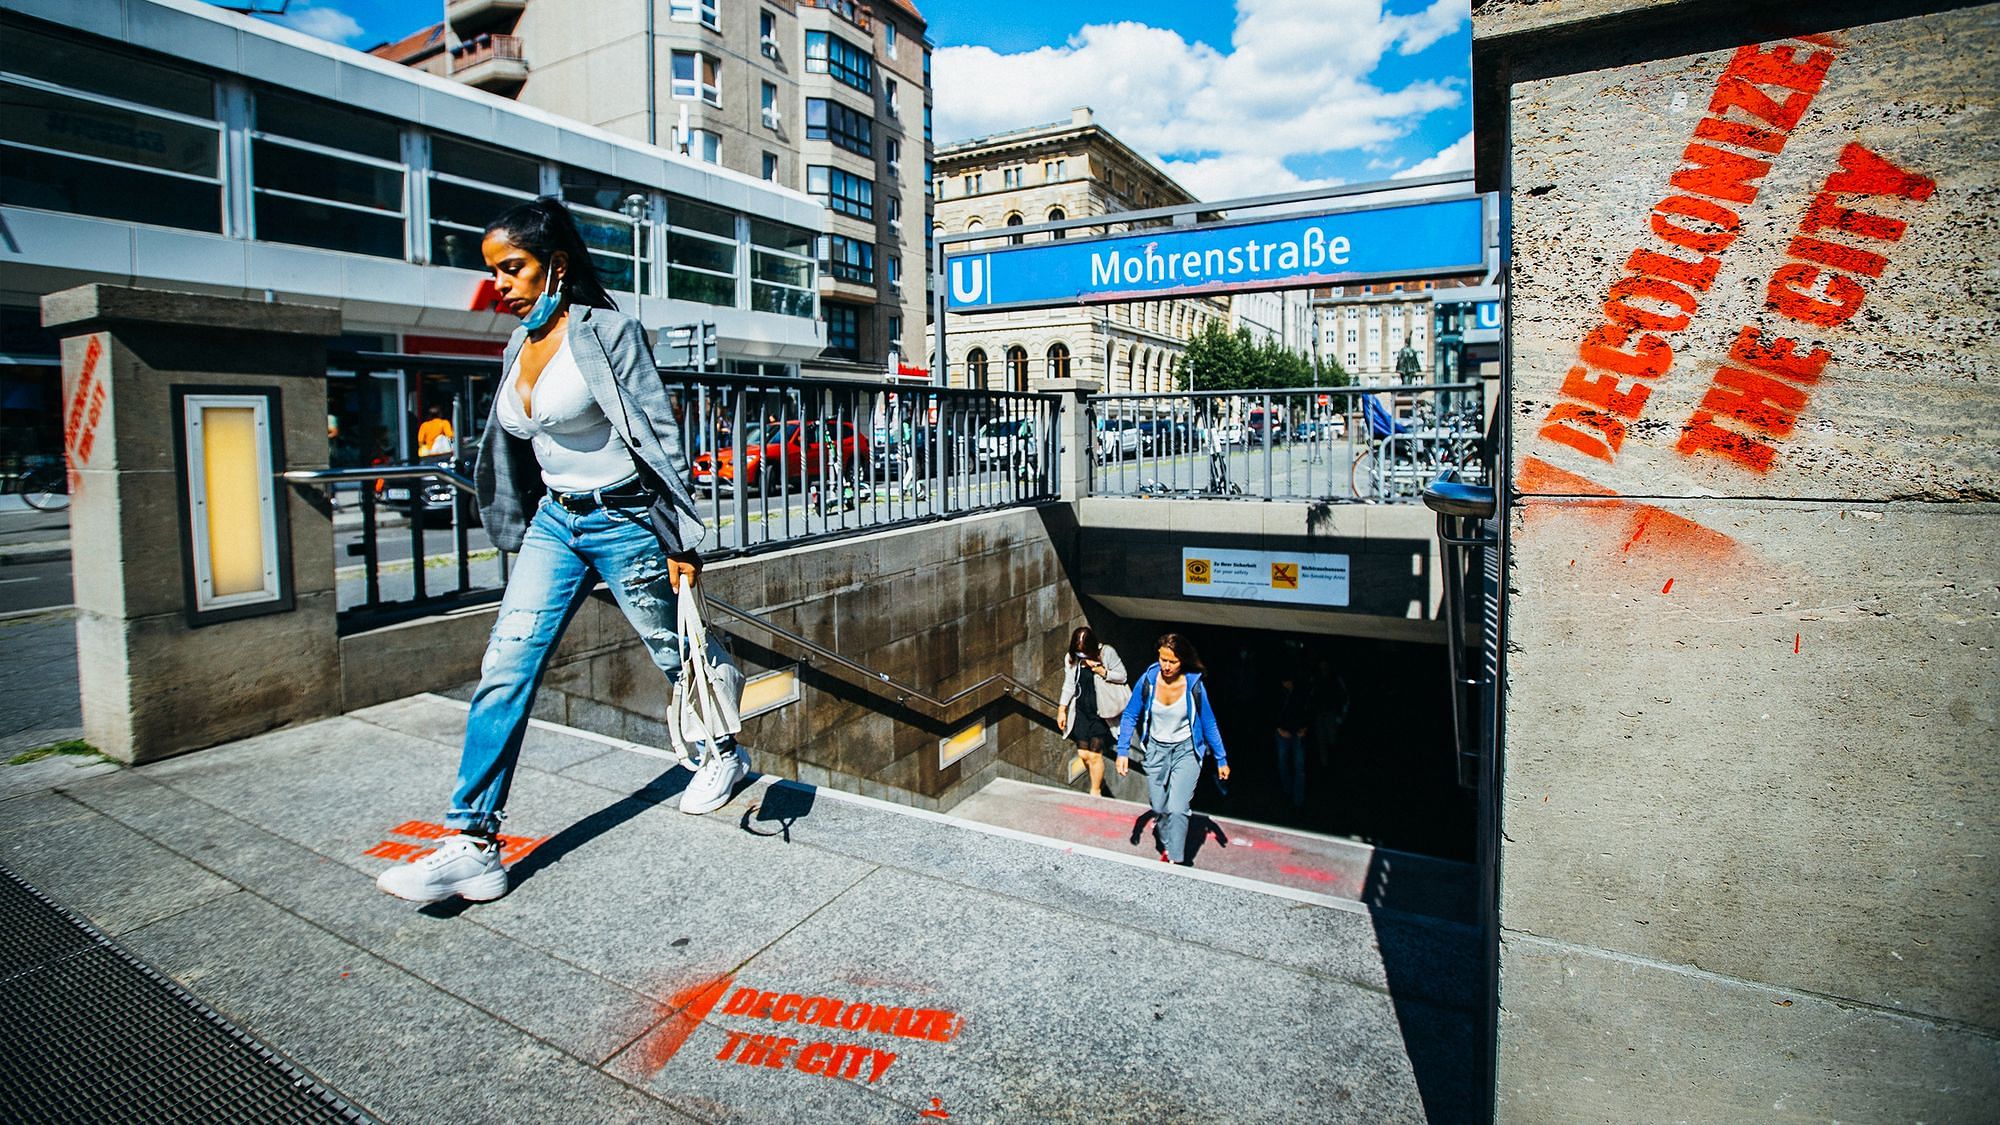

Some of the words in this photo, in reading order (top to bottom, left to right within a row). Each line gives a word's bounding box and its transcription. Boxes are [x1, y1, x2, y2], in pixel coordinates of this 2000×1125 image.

[952, 259, 983, 303] U
[1091, 227, 1351, 286] Mohrenstraße
[1538, 43, 1836, 464] DECOLONIZE
[1482, 304, 1500, 327] U
[1675, 325, 1832, 474] THE
[1766, 141, 1936, 329] CITY
[1190, 575, 1208, 583] Video
[722, 986, 957, 1043] DECOLONIZE
[715, 1031, 799, 1069] THE
[796, 1041, 897, 1083] CITY
